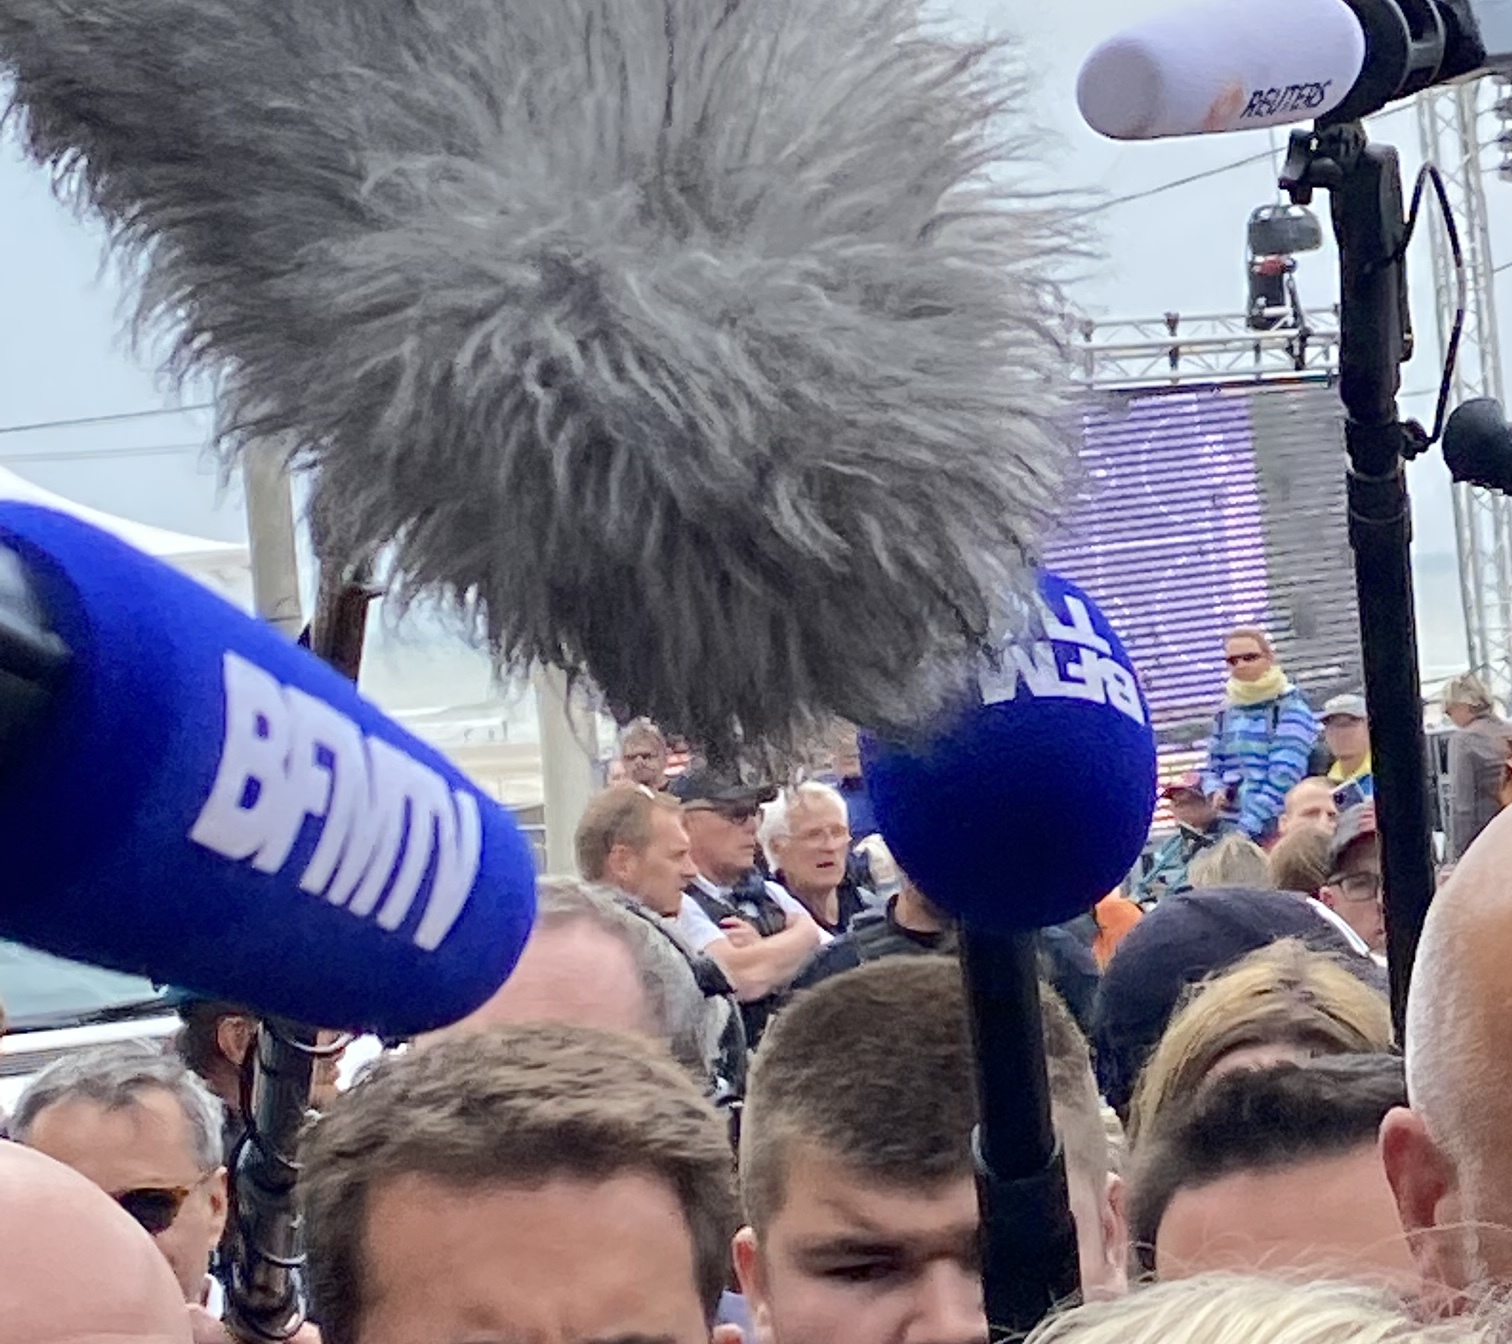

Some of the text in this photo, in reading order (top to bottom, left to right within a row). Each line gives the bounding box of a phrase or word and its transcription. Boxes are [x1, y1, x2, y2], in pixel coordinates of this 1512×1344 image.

[1239, 78, 1333, 119] REUTERS
[972, 636, 1146, 726] BFM
[189, 649, 482, 951] BFMTV
